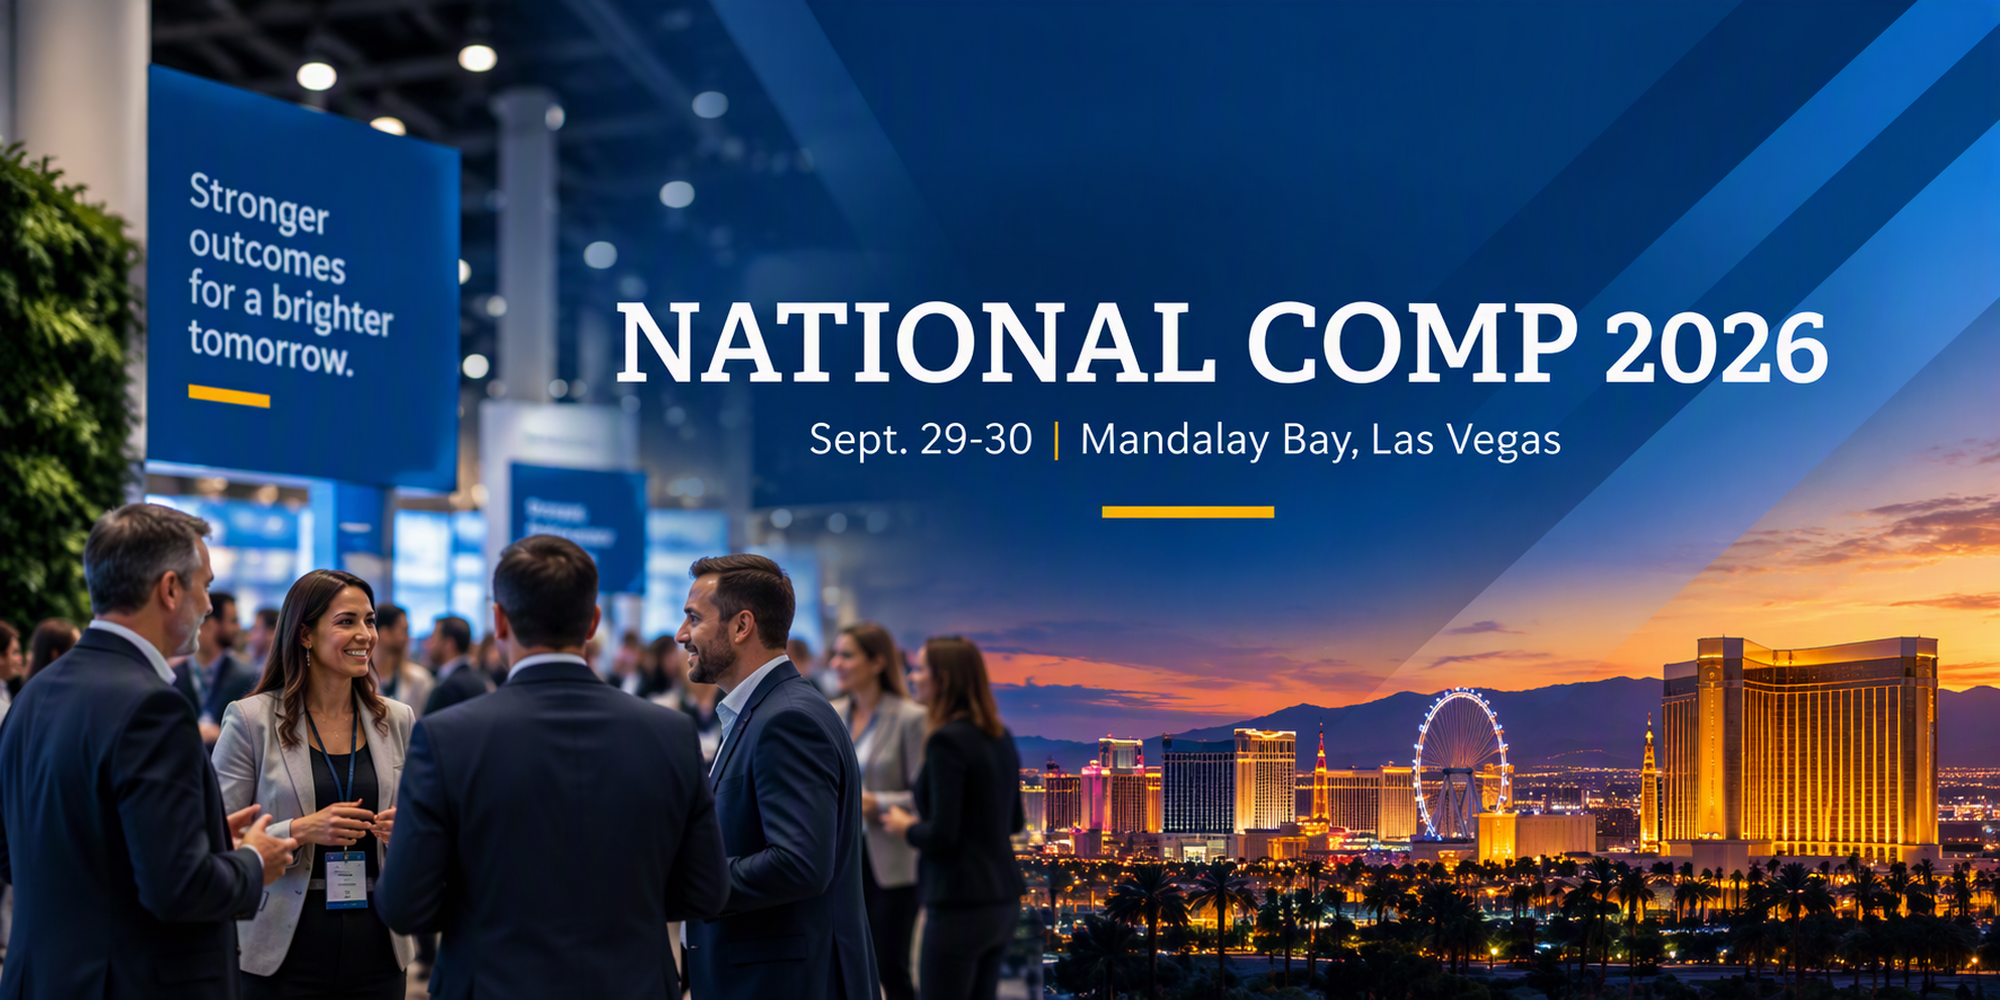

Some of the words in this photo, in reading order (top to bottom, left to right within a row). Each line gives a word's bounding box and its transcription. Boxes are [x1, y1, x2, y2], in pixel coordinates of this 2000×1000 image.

[190, 172, 330, 237] Stronger
[189, 229, 346, 285] outcomes
[188, 267, 236, 310] for
[244, 287, 262, 316] a
[273, 283, 394, 337] brighter
[188, 319, 354, 377] tomorrow.
